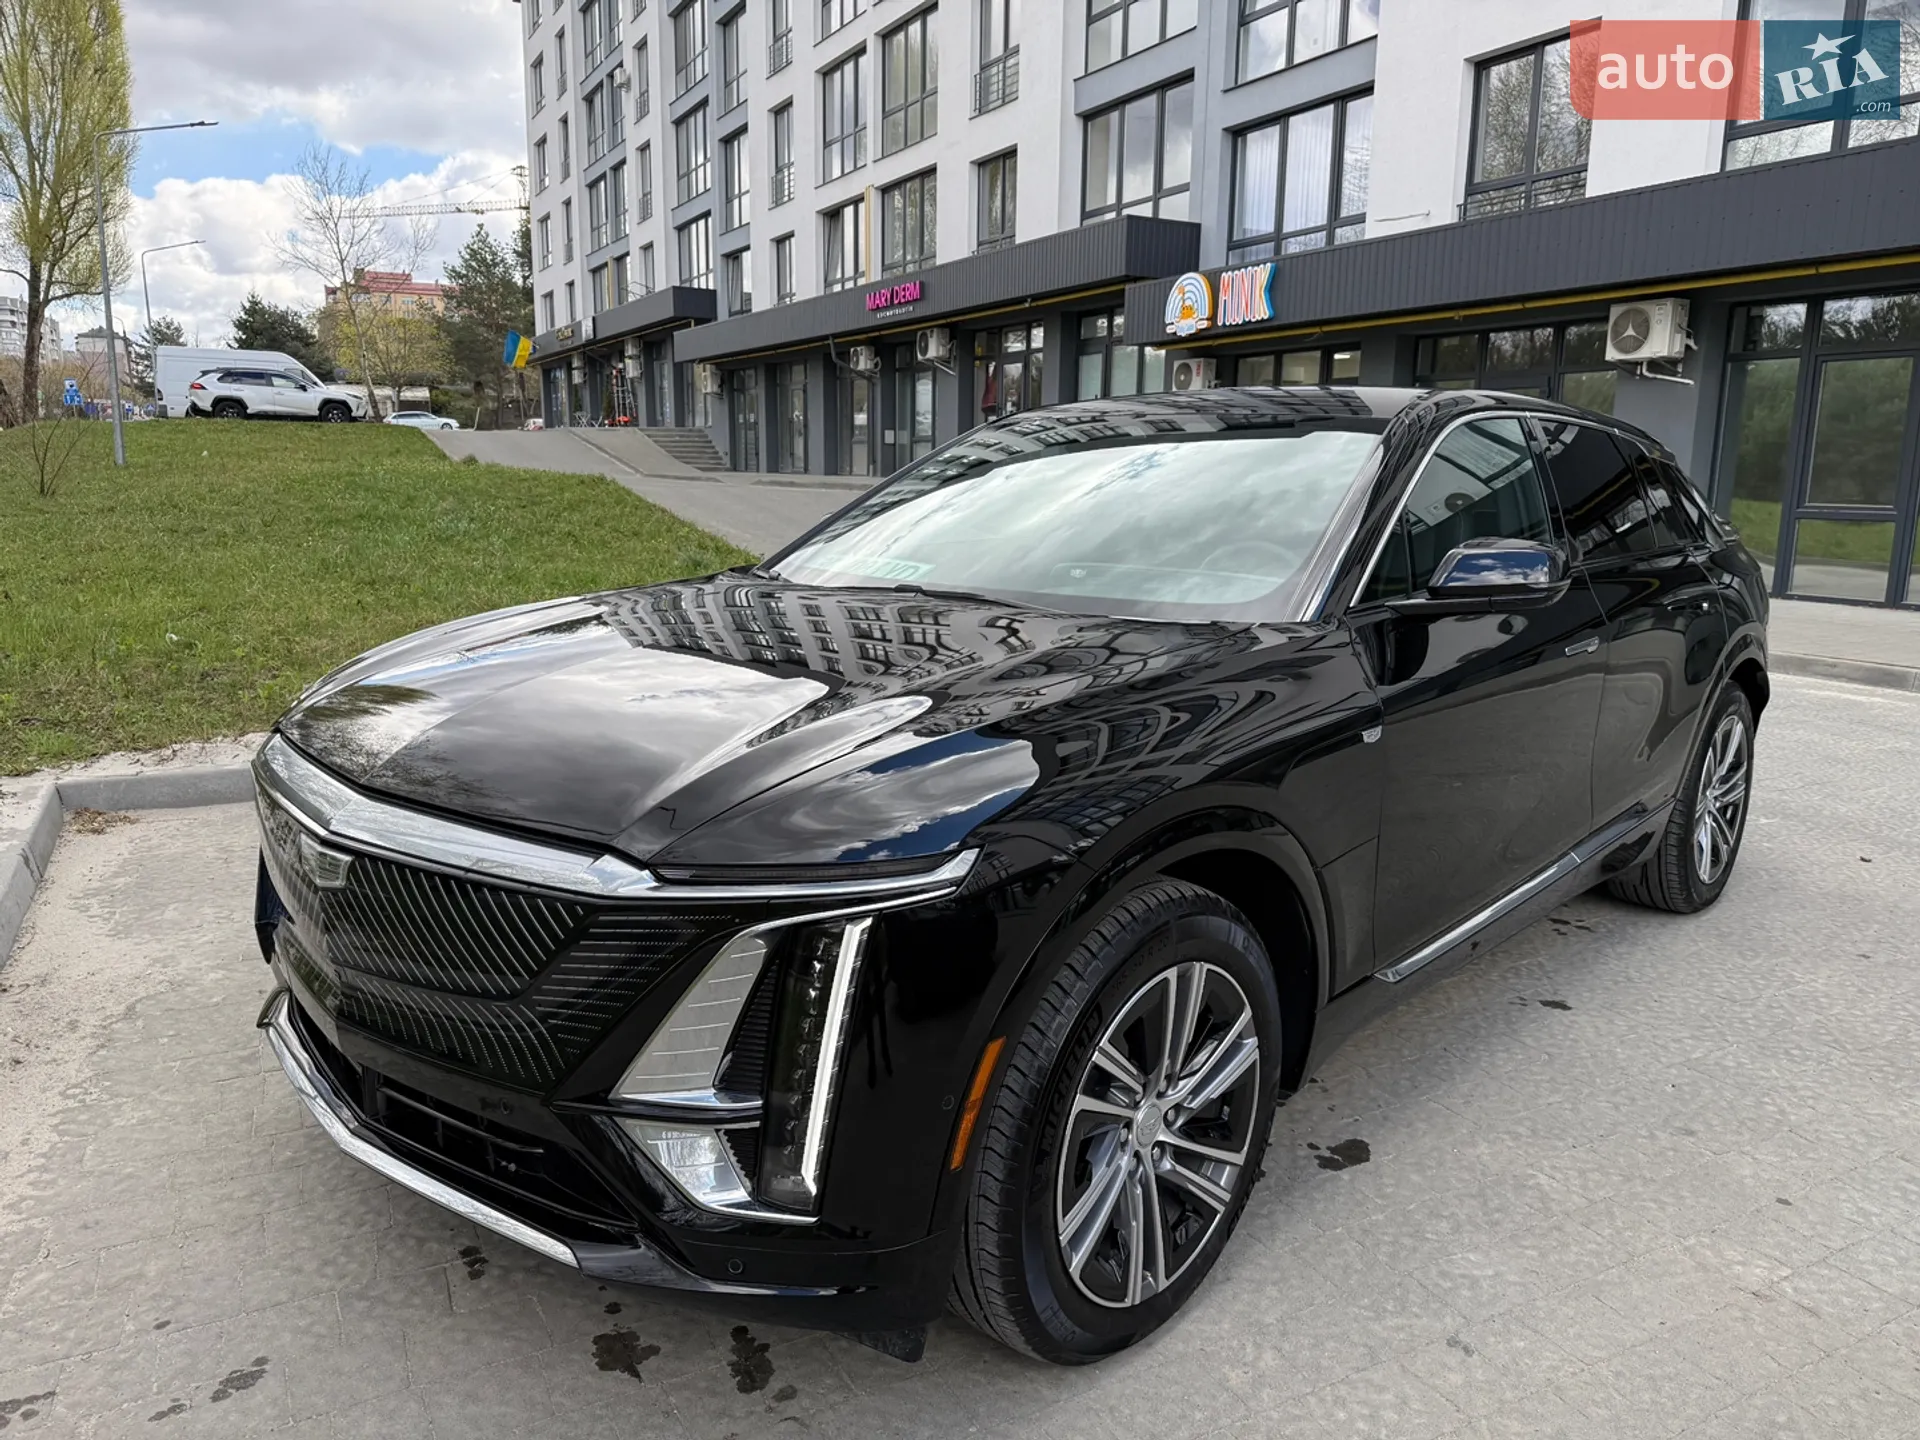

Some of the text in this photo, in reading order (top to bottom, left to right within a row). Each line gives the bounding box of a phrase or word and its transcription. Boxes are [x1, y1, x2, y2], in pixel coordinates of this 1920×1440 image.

[865, 280, 921, 311] MARY DERM
[1217, 263, 1273, 326] MINIK
[1041, 1007, 1101, 1152] MICHELIN
